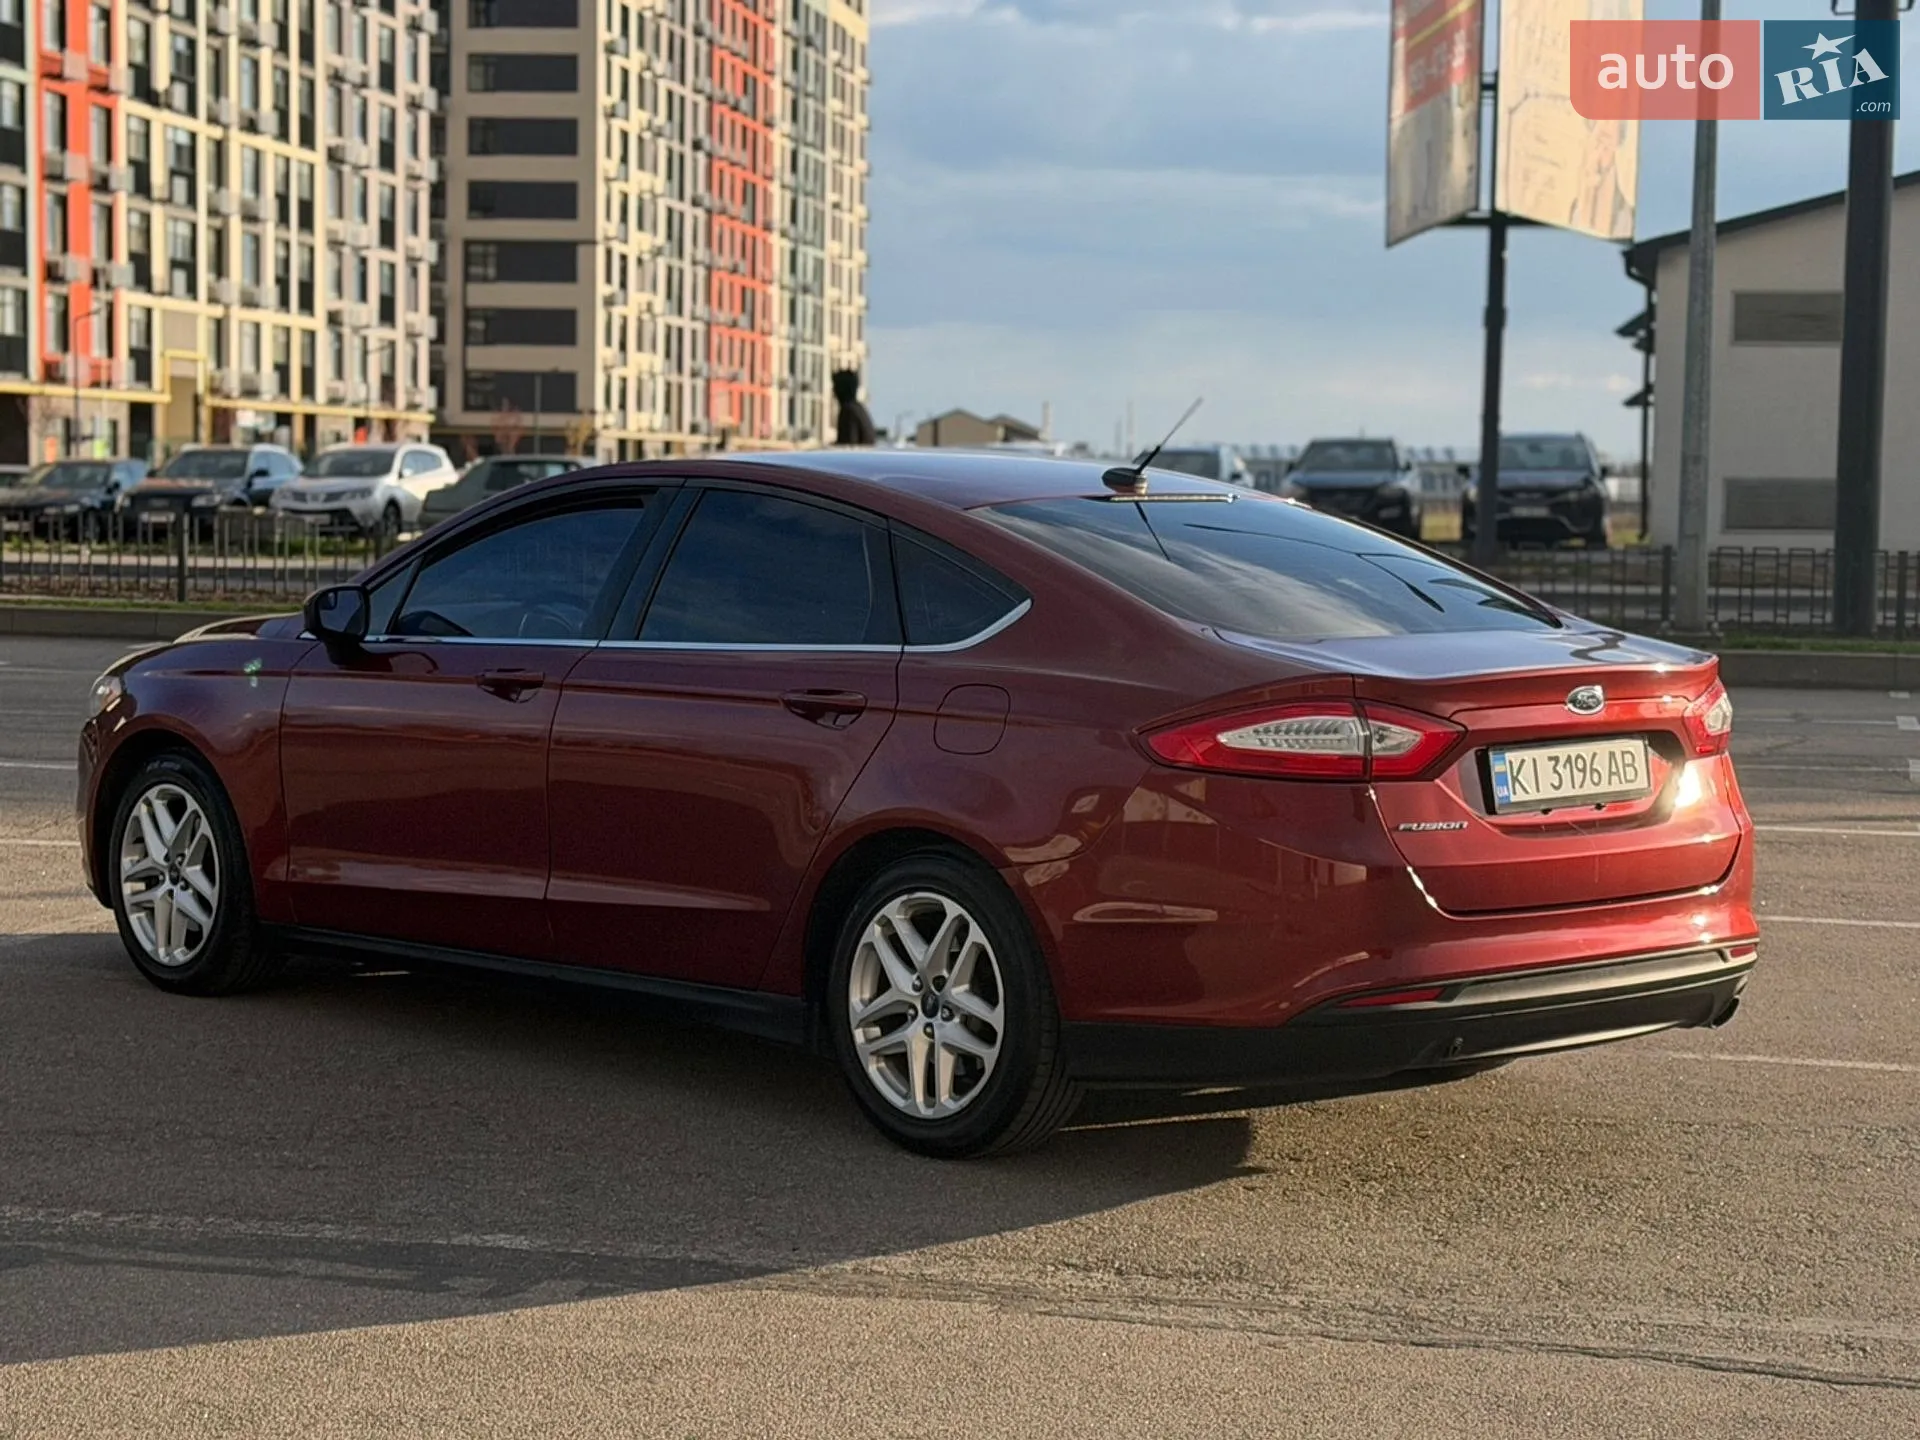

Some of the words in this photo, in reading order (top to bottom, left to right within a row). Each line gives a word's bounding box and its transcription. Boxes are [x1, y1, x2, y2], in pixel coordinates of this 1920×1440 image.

[1509, 757, 1540, 796] KI
[1547, 752, 1602, 790] 3196
[1608, 750, 1638, 786] AB
